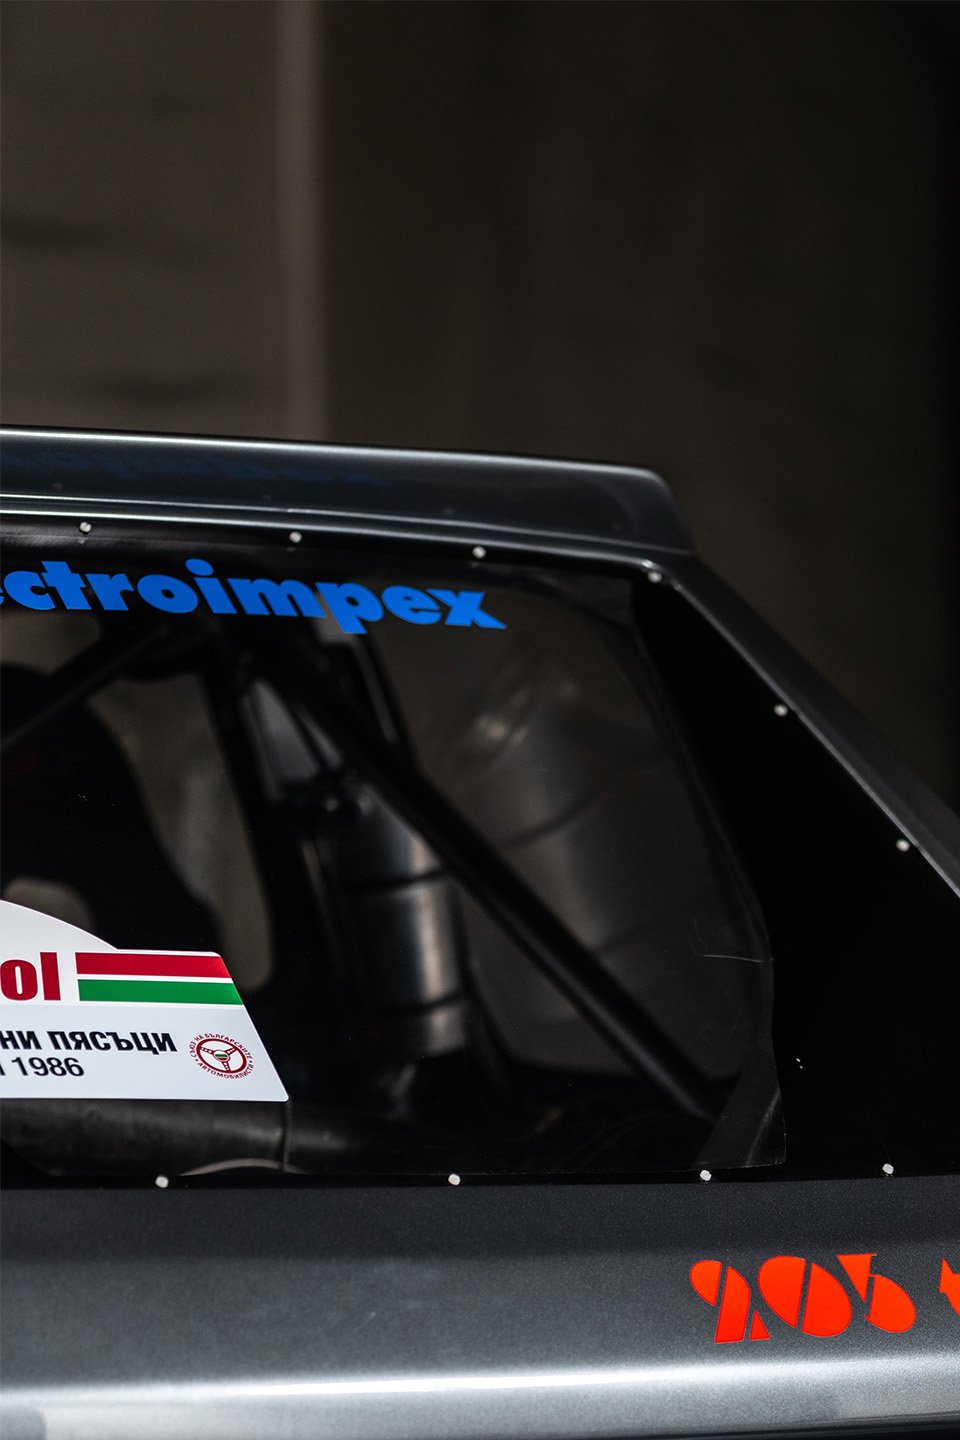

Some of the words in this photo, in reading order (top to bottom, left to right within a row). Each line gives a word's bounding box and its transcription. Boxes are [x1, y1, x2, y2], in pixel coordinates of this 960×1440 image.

[0, 558, 506, 634] ctroimpex
[0, 951, 61, 1001] ol
[11, 1056, 84, 1077] 1986
[46, 1031, 178, 1055] ПЯСЪЦИ
[690, 1253, 916, 1343] 205
